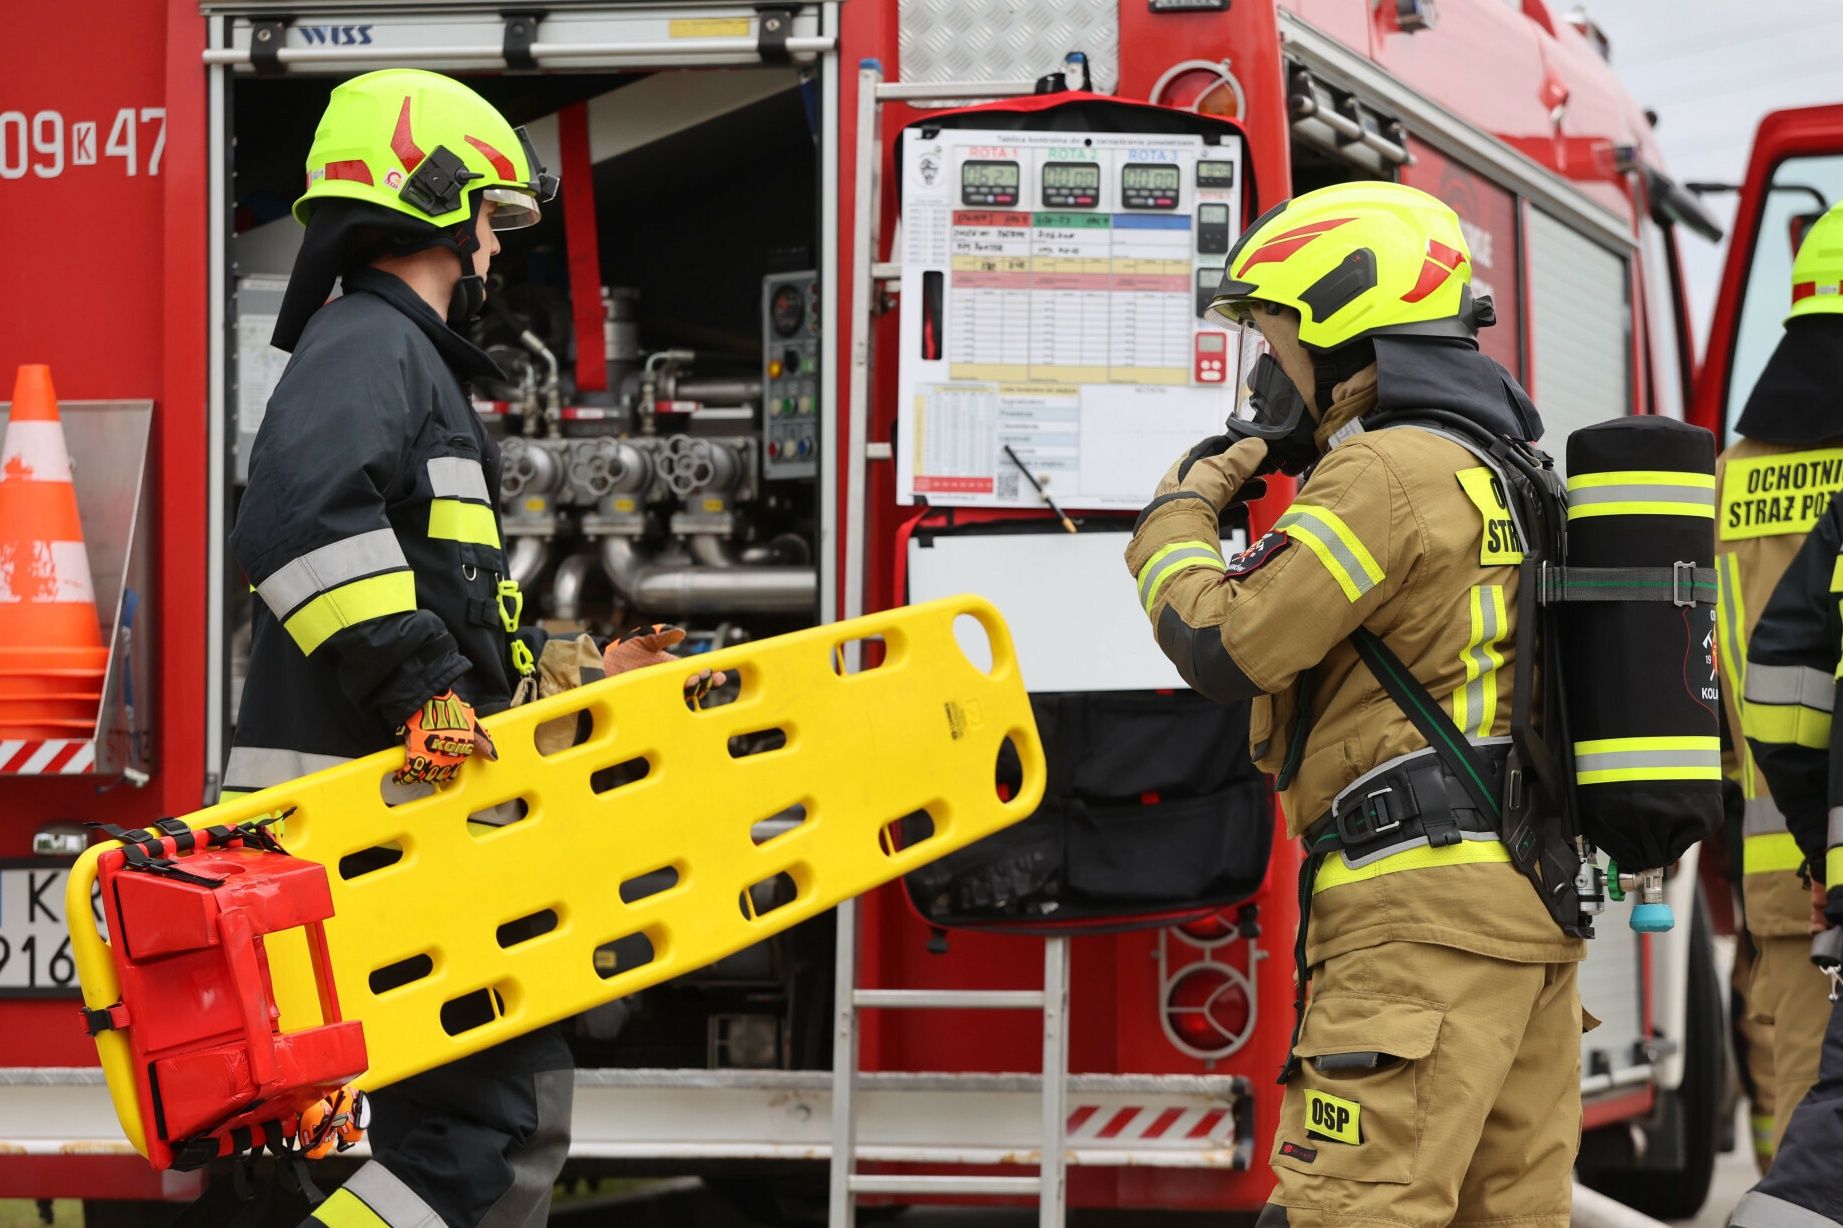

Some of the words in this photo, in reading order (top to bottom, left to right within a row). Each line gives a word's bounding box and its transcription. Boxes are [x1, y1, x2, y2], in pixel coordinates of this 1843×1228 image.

[969, 146, 1008, 159] ROTA
[1048, 148, 1086, 160] ROTA
[1129, 149, 1167, 161] ROTA
[431, 738, 475, 754] KONG
[1312, 1097, 1350, 1133] OSP
